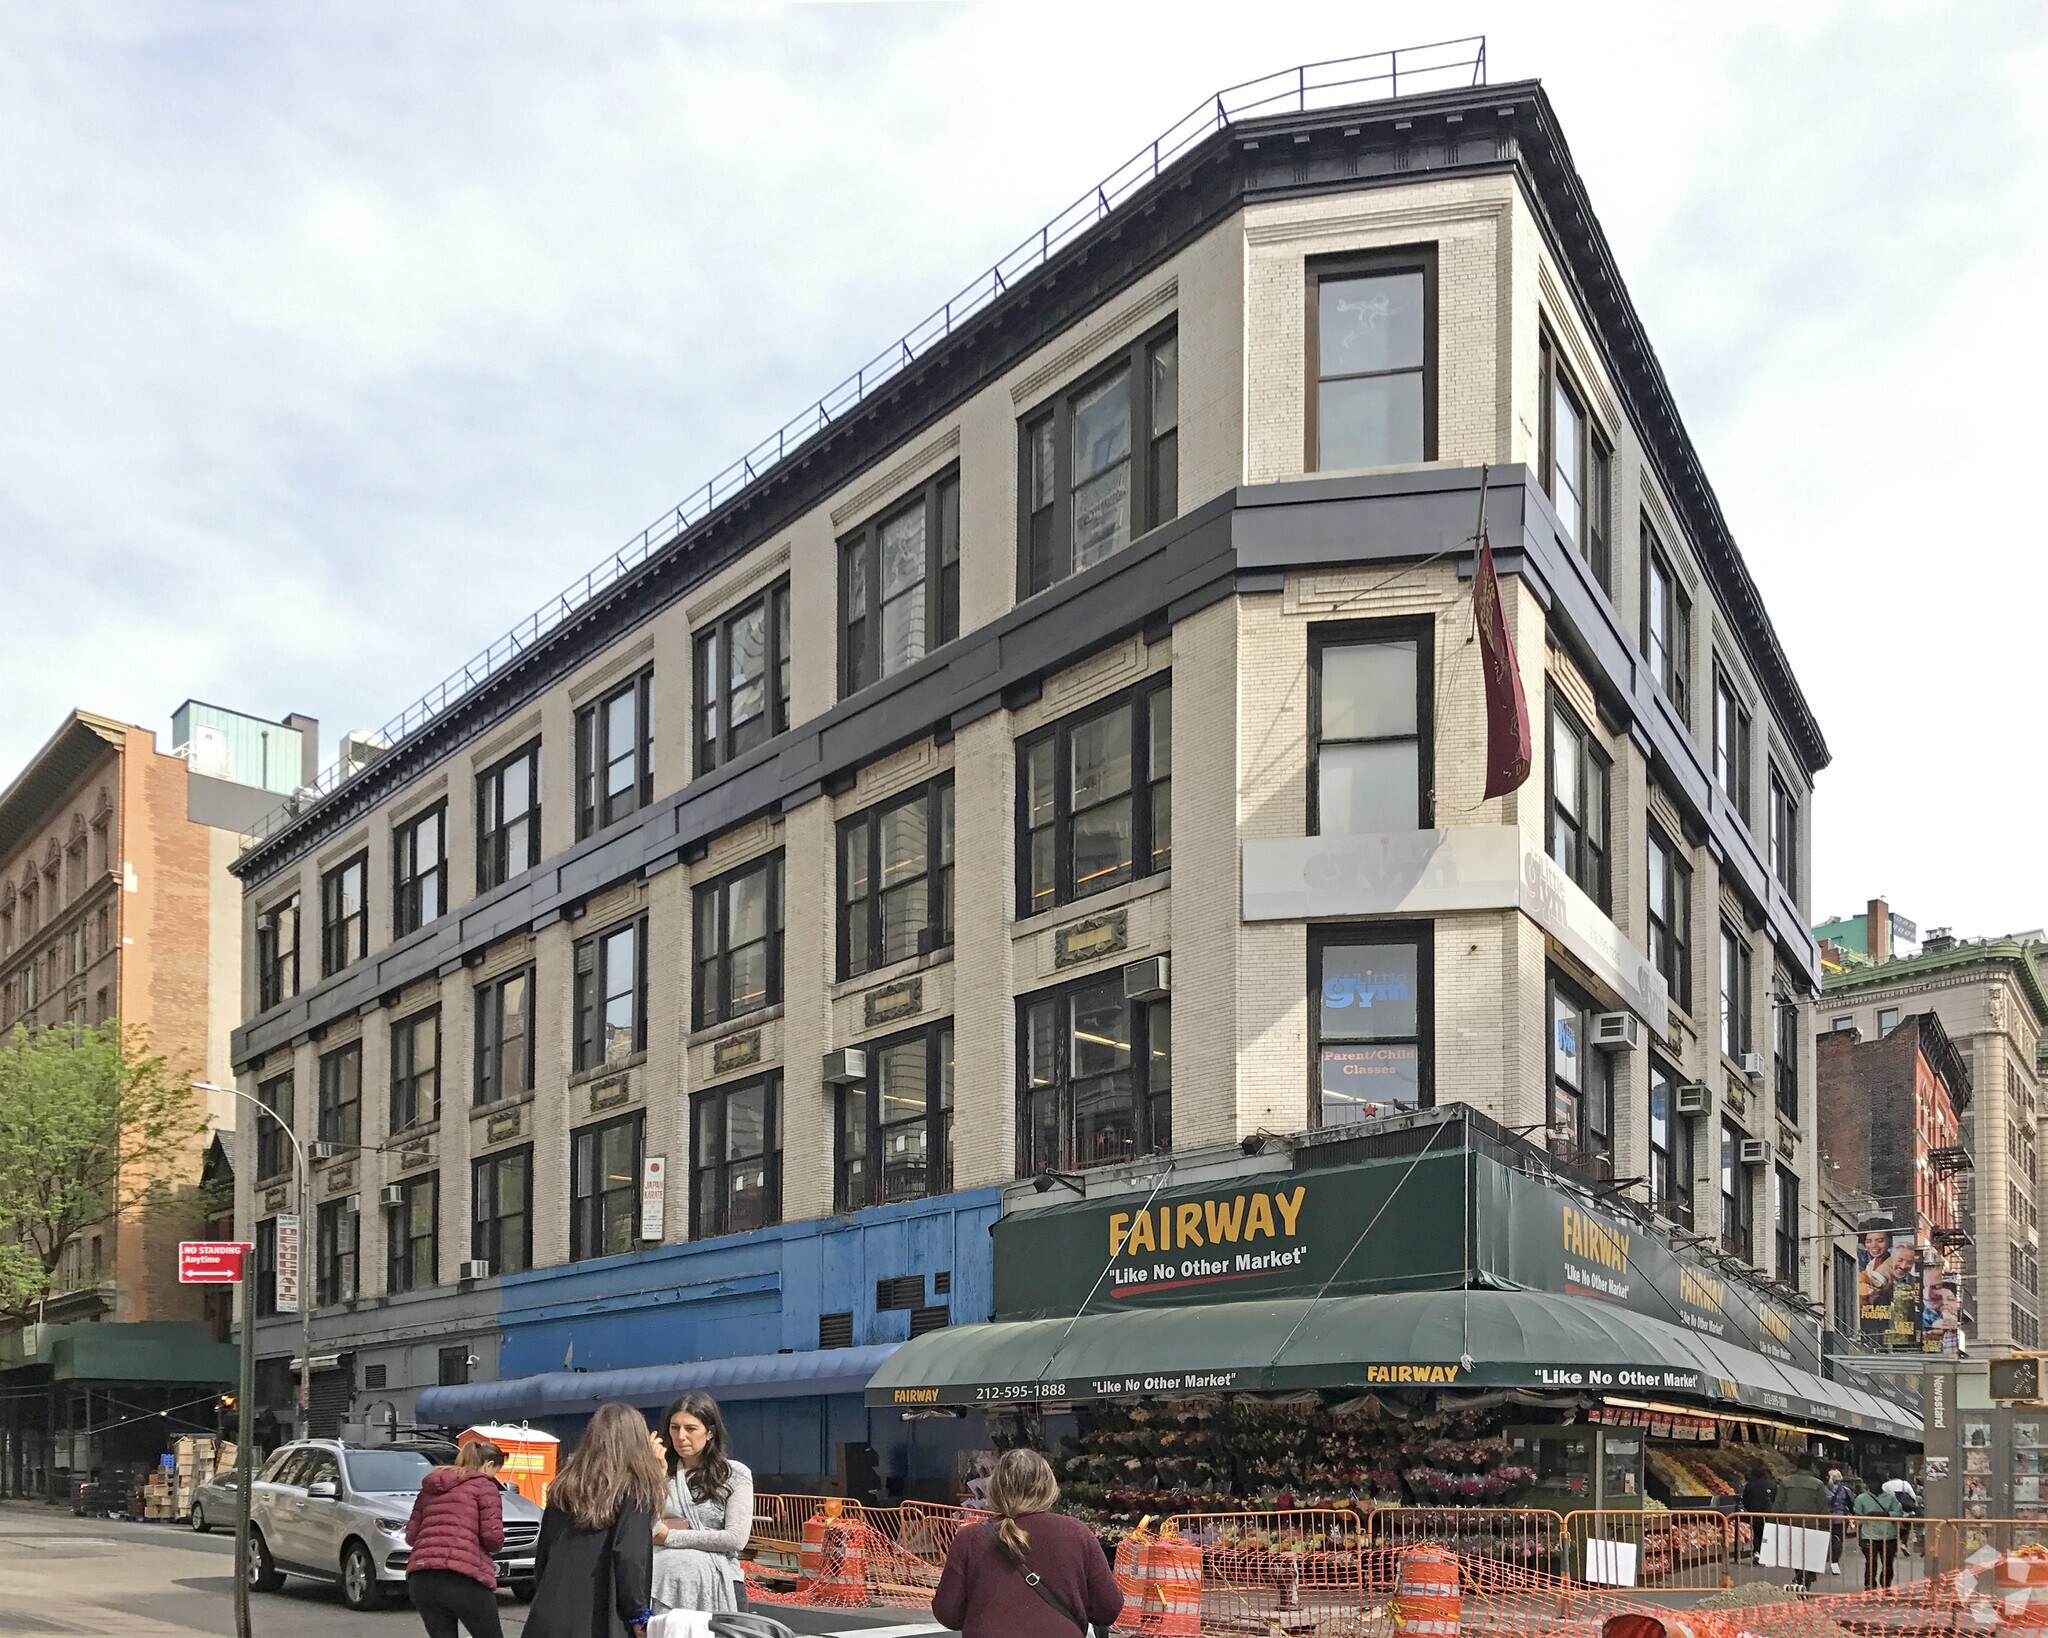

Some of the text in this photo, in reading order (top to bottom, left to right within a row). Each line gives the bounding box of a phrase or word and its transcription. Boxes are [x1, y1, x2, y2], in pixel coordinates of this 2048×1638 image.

[1324, 977, 1409, 1009] gym
[1324, 1050, 1415, 1061] Parent/Child
[1343, 1064, 1397, 1075] Classes
[1109, 1186, 1307, 1256] FAIRWAY
[184, 1246, 241, 1255] NO STANDING
[1563, 1206, 1630, 1275] FAIRWAY
[184, 1256, 220, 1265] Anytime
[279, 1228, 297, 1302] DEMOCRATS
[1109, 1246, 1307, 1284] "Like No Other Market"
[1581, 1269, 1591, 1286] No
[1591, 1272, 1608, 1292] Other
[1680, 1264, 1724, 1316] FAIRWAY
[1092, 1373, 1237, 1395] "Like No Other Market"
[1367, 1365, 1459, 1383] FAIRWAY
[1534, 1369, 1583, 1385] "Like
[1589, 1370, 1613, 1385] No
[1618, 1370, 1660, 1387] Other
[894, 1388, 939, 1403] FAIRWAY
[976, 1383, 1066, 1400] 212-595-1888
[1934, 1375, 1946, 1428] Newsstand
